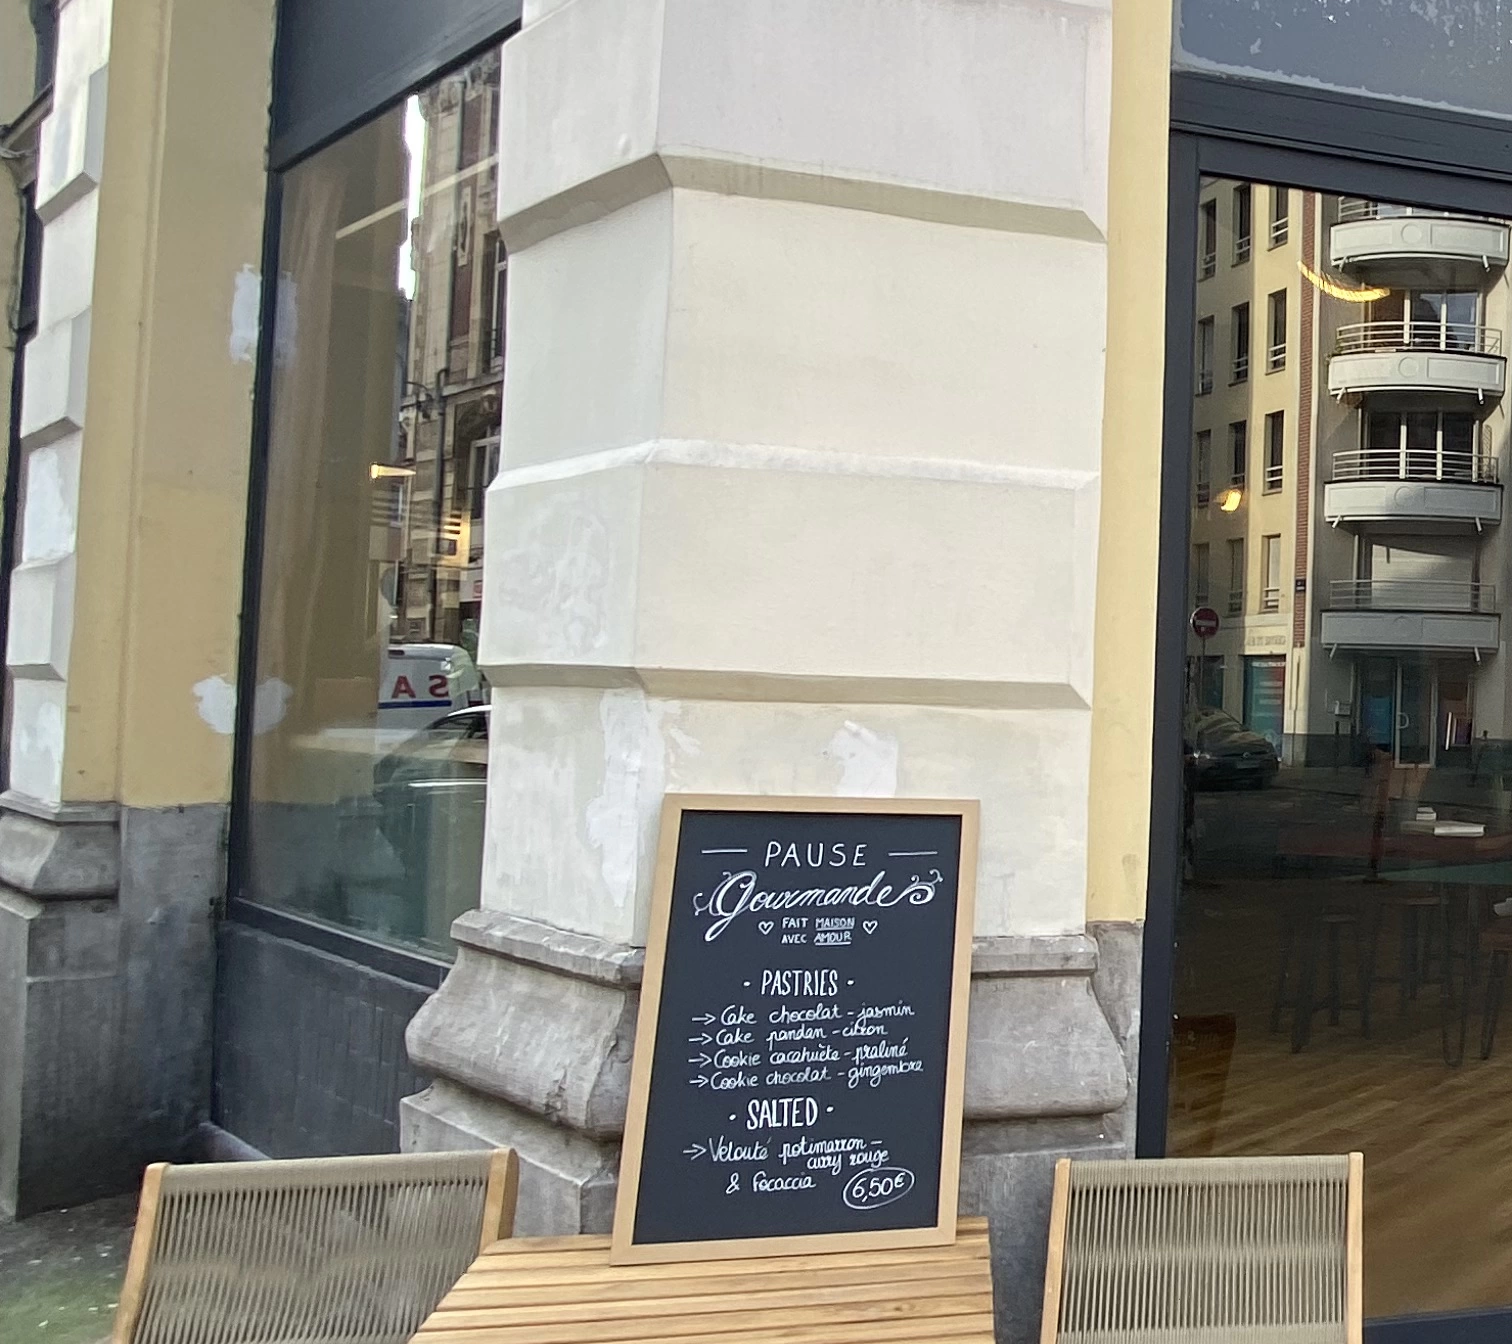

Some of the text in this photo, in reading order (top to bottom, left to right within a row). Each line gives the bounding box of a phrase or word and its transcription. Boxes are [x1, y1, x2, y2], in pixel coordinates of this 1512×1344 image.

[764, 840, 868, 868] PAUSE
[782, 917, 855, 930] FAIT MAISON
[781, 932, 852, 945] AVEC AMOUR
[761, 969, 839, 997] PASTRIES
[720, 1004, 758, 1026] Cake
[768, 1002, 843, 1024] chocolat
[856, 1000, 915, 1027] jasmin
[715, 1028, 755, 1046] Cake
[766, 1023, 827, 1051] pandan
[842, 1022, 888, 1038] citron
[713, 1048, 761, 1069] Cookie
[851, 1037, 908, 1065] praliné
[710, 1071, 759, 1090] Cookie
[765, 1067, 831, 1087] chocolat
[848, 1058, 924, 1090] gingembre
[747, 1097, 819, 1130] SALTED
[708, 1134, 772, 1162] Velouté
[778, 1136, 867, 1165] potimarron
[807, 1148, 890, 1176] curry rouge
[725, 1172, 740, 1194] &
[852, 1171, 906, 1203] 6,50€
